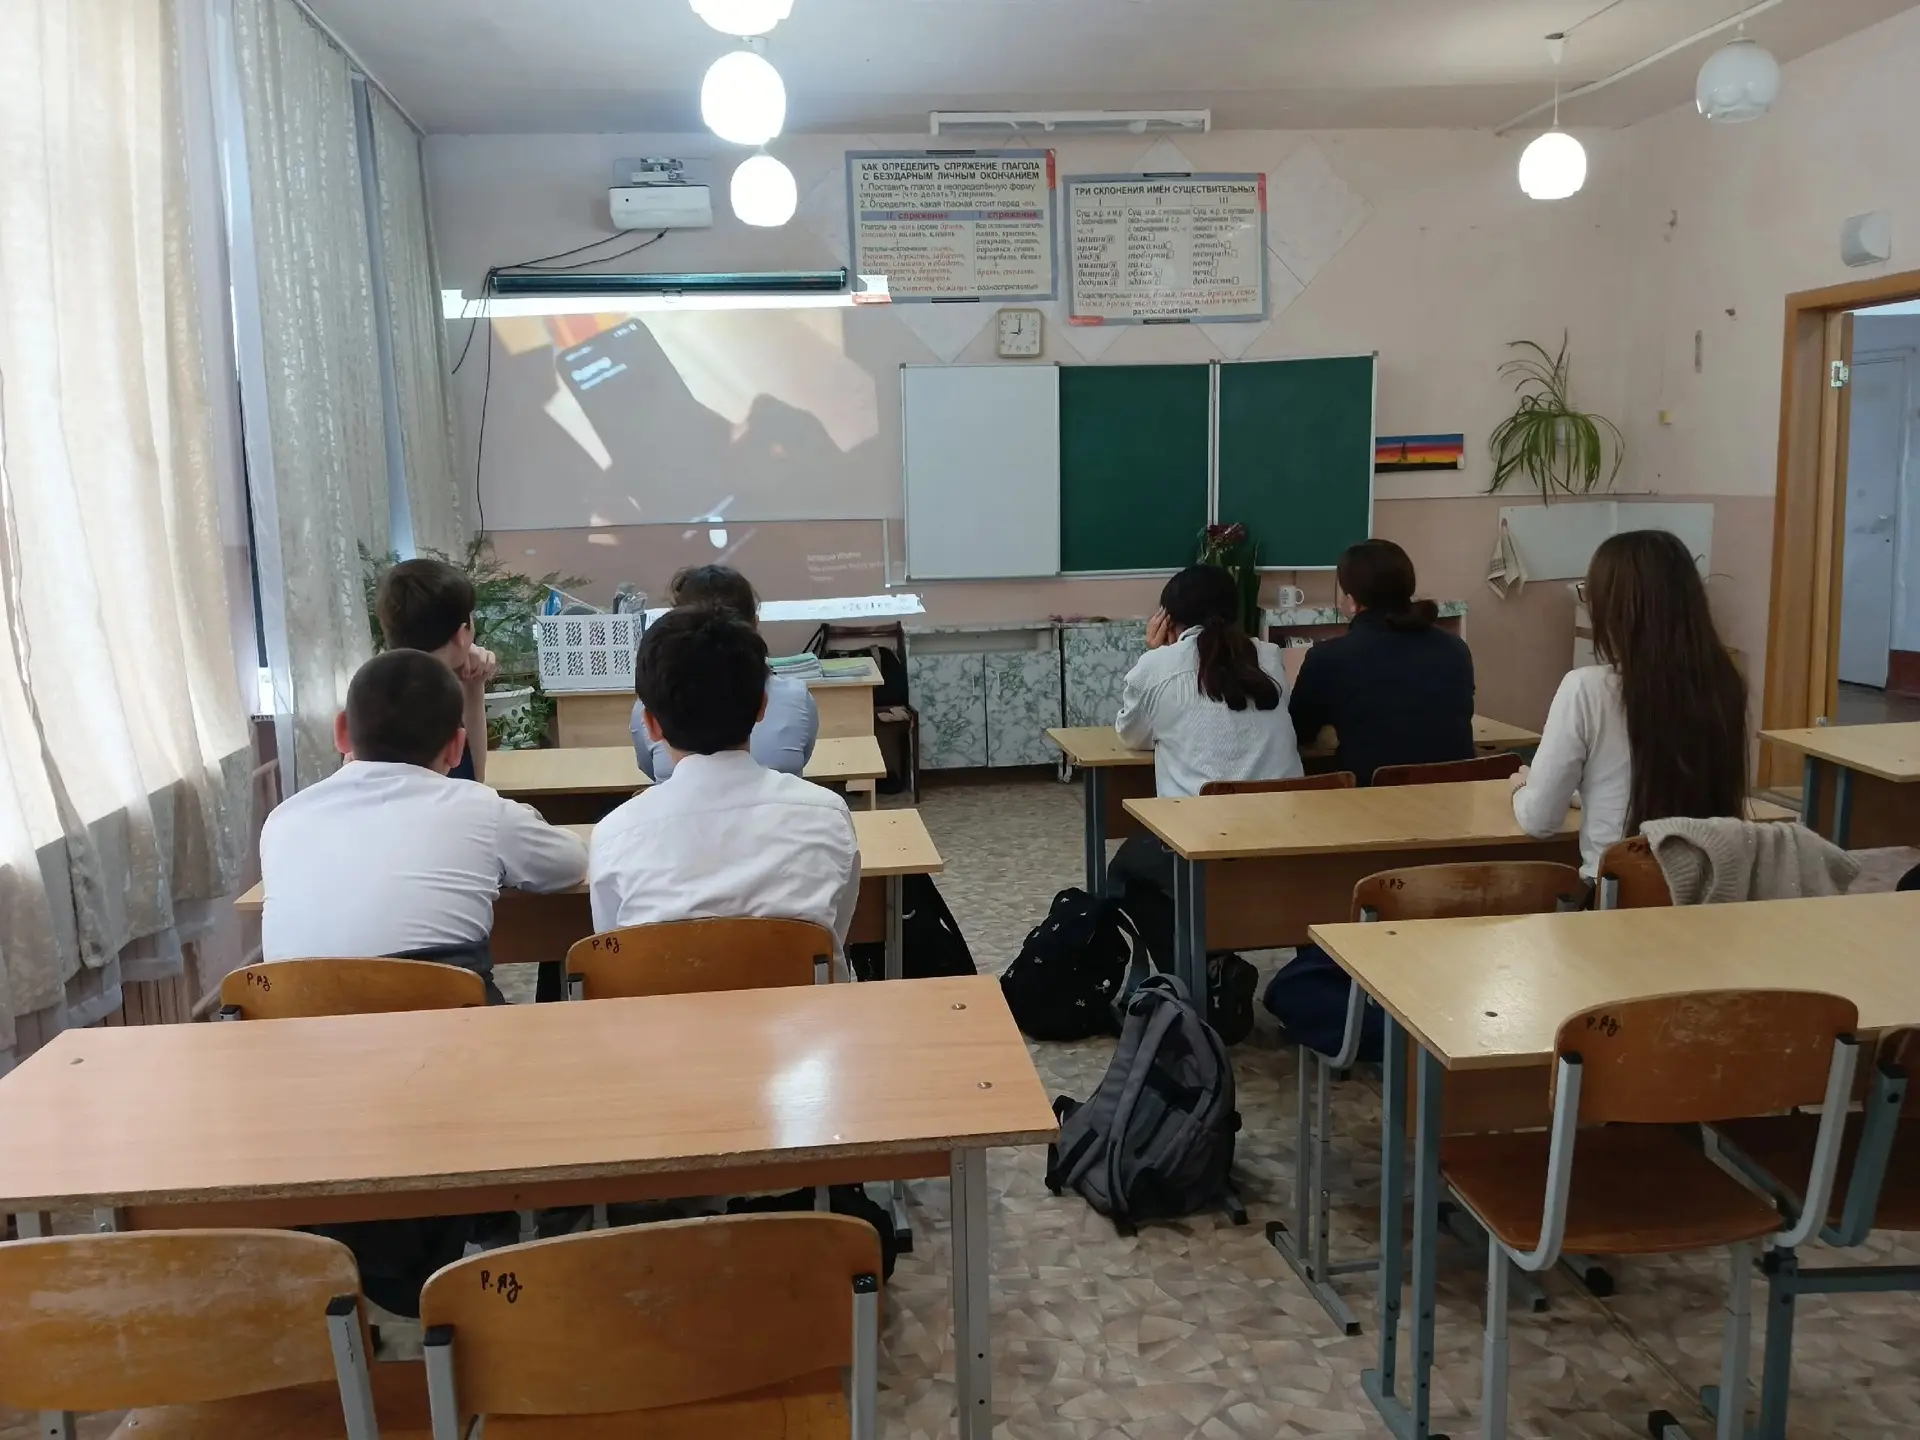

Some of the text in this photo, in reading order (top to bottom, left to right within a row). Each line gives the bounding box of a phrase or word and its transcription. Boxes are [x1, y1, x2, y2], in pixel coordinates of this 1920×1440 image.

[861, 161, 1040, 172] КАК ОПРЕДЕЛИТЬ СПРЯЖЕНИЕ ГЛАГОЛА
[862, 171, 1040, 181] С БЕЗУДАРНЫМ ЛИЧНЫМ ОКОНЧАНИЕМ
[868, 182, 908, 192] Поставить
[911, 183, 935, 191] глагол
[1010, 182, 1036, 193] форму
[1074, 184, 1256, 197] ТРИ СКЛОНЕНИЯ ИМЁН СУЩЕСТВИТЕЛЬНЫХ
[1155, 196, 1162, 206] II
[1218, 195, 1229, 205] III
[898, 211, 949, 221] спряжение
[987, 211, 1038, 220] спряжение
